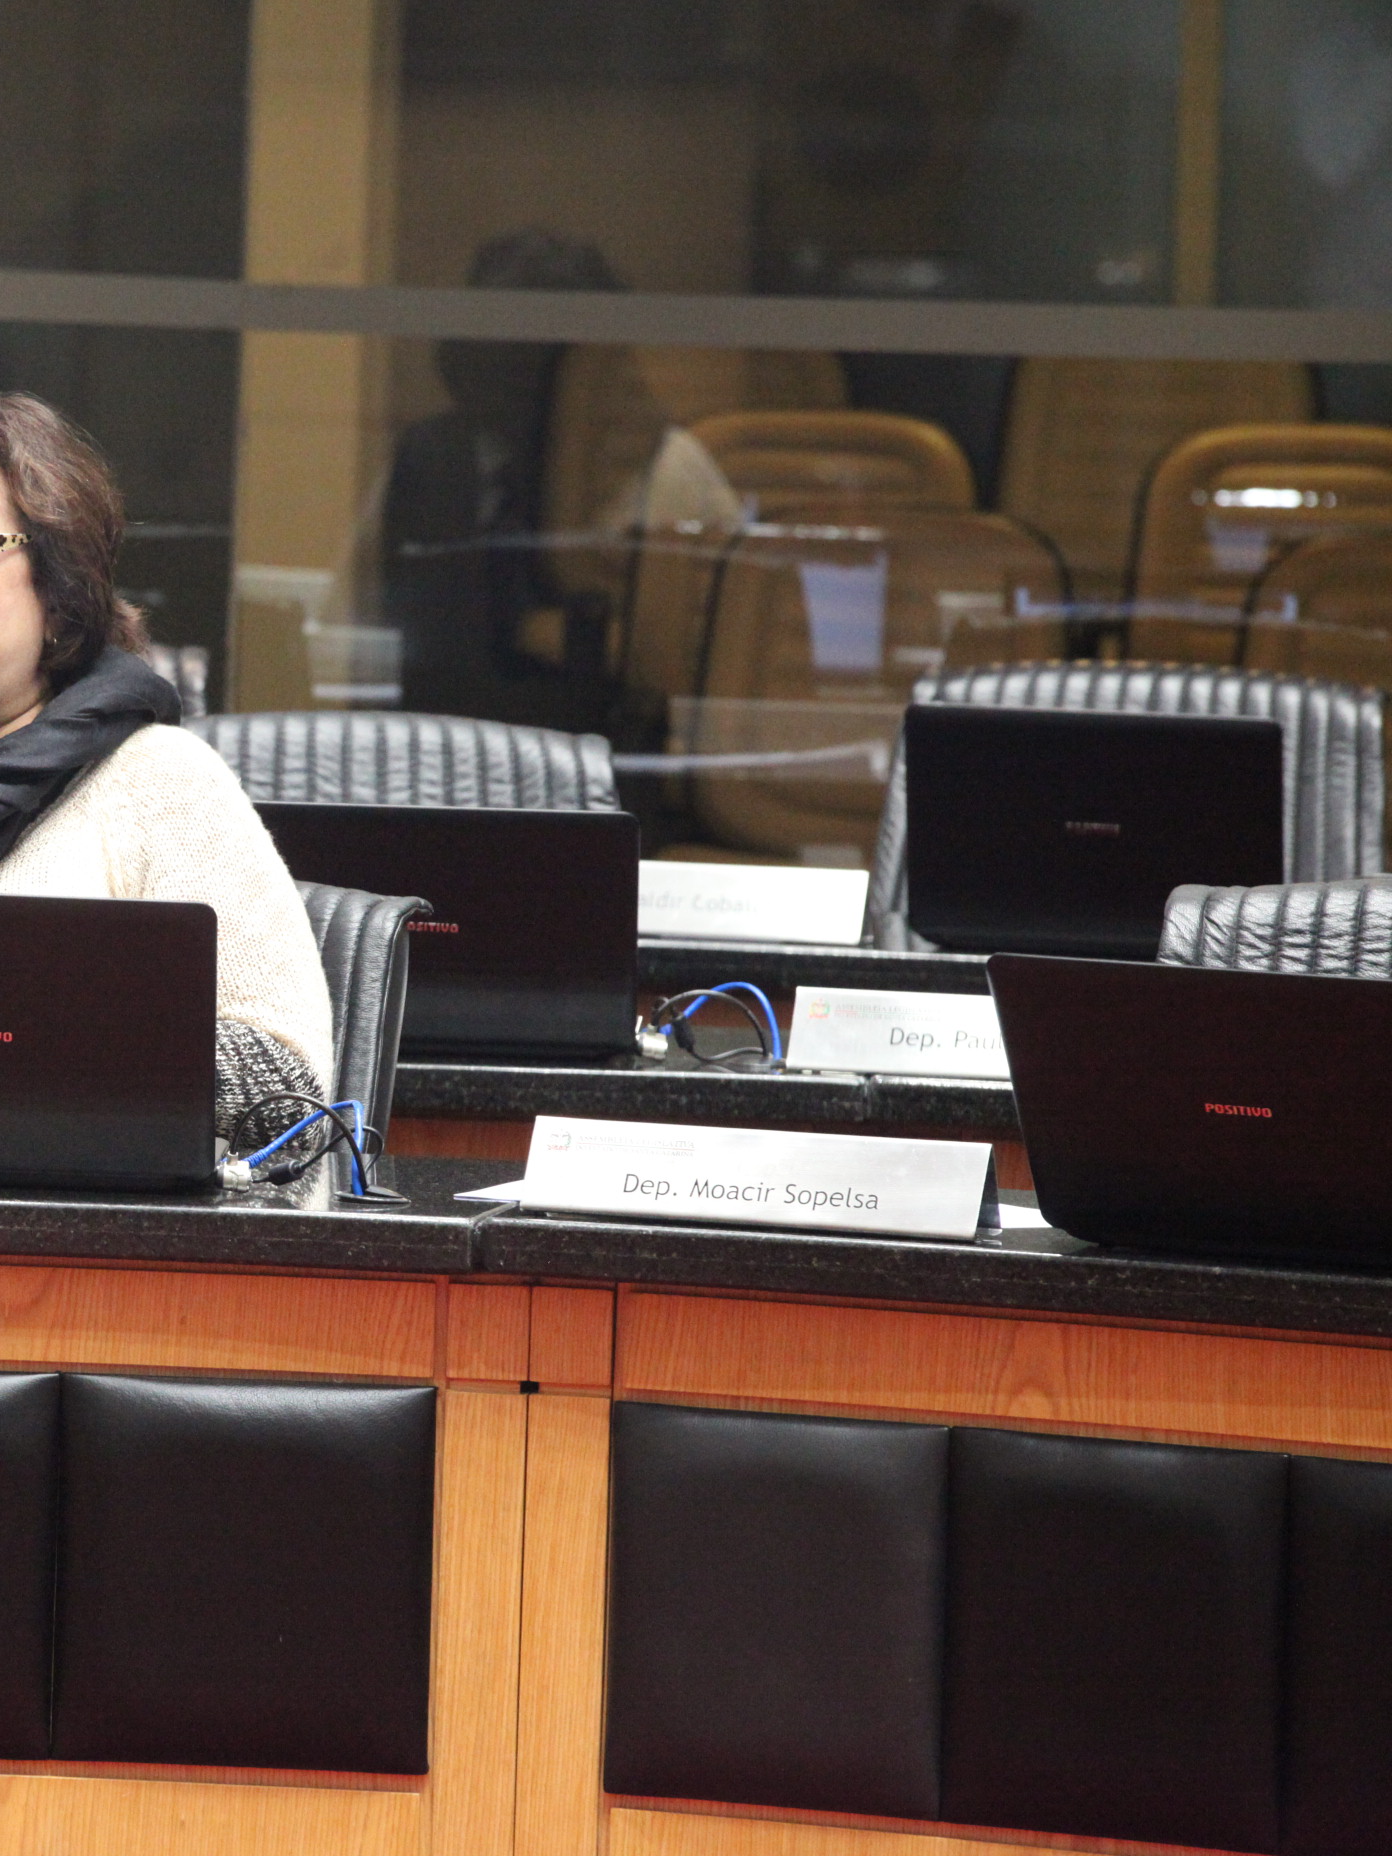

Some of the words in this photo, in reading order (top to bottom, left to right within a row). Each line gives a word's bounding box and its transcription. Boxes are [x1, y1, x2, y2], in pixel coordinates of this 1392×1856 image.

[407, 921, 459, 934] OSITIVO
[889, 1026, 941, 1052] Dep.
[954, 1029, 1005, 1050] Paul
[1204, 1103, 1273, 1118] POSITIVO
[622, 1173, 678, 1200] Dep.
[689, 1178, 775, 1203] Moacir
[784, 1183, 879, 1211] Sopelsa
